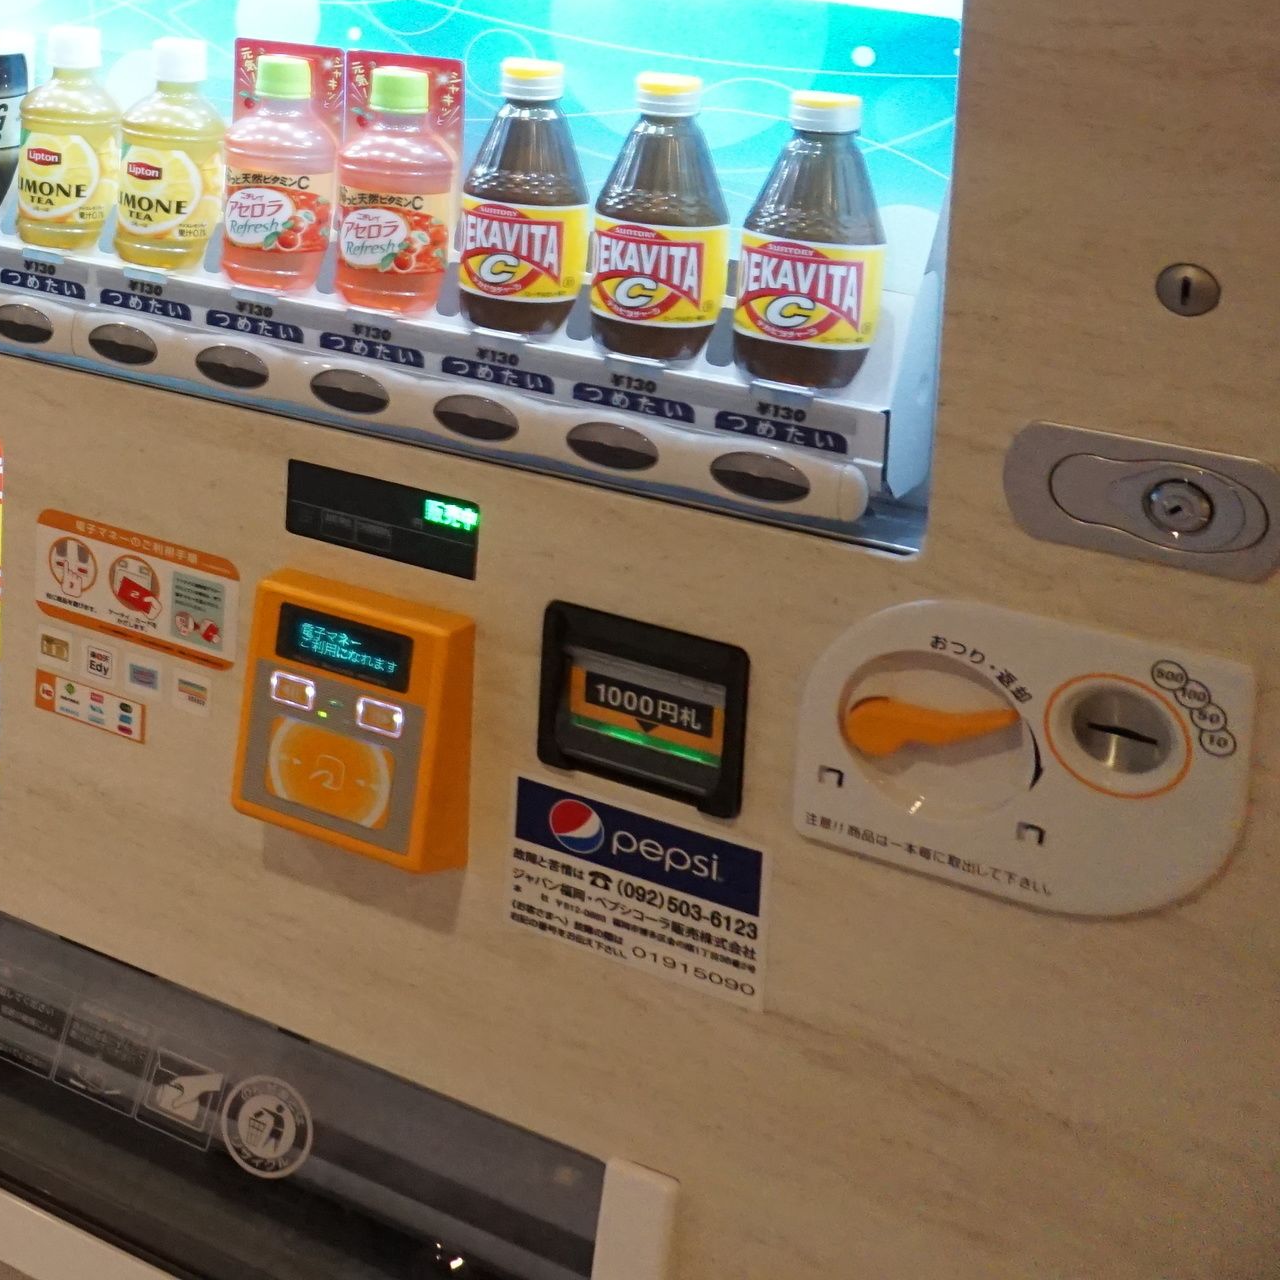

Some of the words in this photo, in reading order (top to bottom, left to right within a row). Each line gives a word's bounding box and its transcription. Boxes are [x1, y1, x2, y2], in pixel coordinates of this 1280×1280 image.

[27, 150, 60, 165] Lipton
[128, 164, 160, 179] Lipton
[29, 195, 55, 206] TEA
[228, 200, 285, 218] アセロラ
[127, 210, 153, 221] TEA
[229, 218, 279, 236] Refresh
[344, 221, 400, 239] アセロラ
[345, 238, 398, 257] Refresh
[477, 253, 519, 284] C
[109, 290, 183, 315] つめたい
[614, 277, 657, 308] C
[767, 295, 814, 328] C
[727, 412, 835, 449] つめたい
[300, 623, 361, 645] 電子マネー
[89, 662, 109, 675] Edy
[931, 634, 1033, 705] おつり・返却
[595, 683, 702, 730] 1000円札
[1207, 733, 1228, 748] 10
[612, 831, 719, 881] pepsi
[617, 879, 758, 940] (092)503-6123
[632, 946, 756, 996] 01915090
